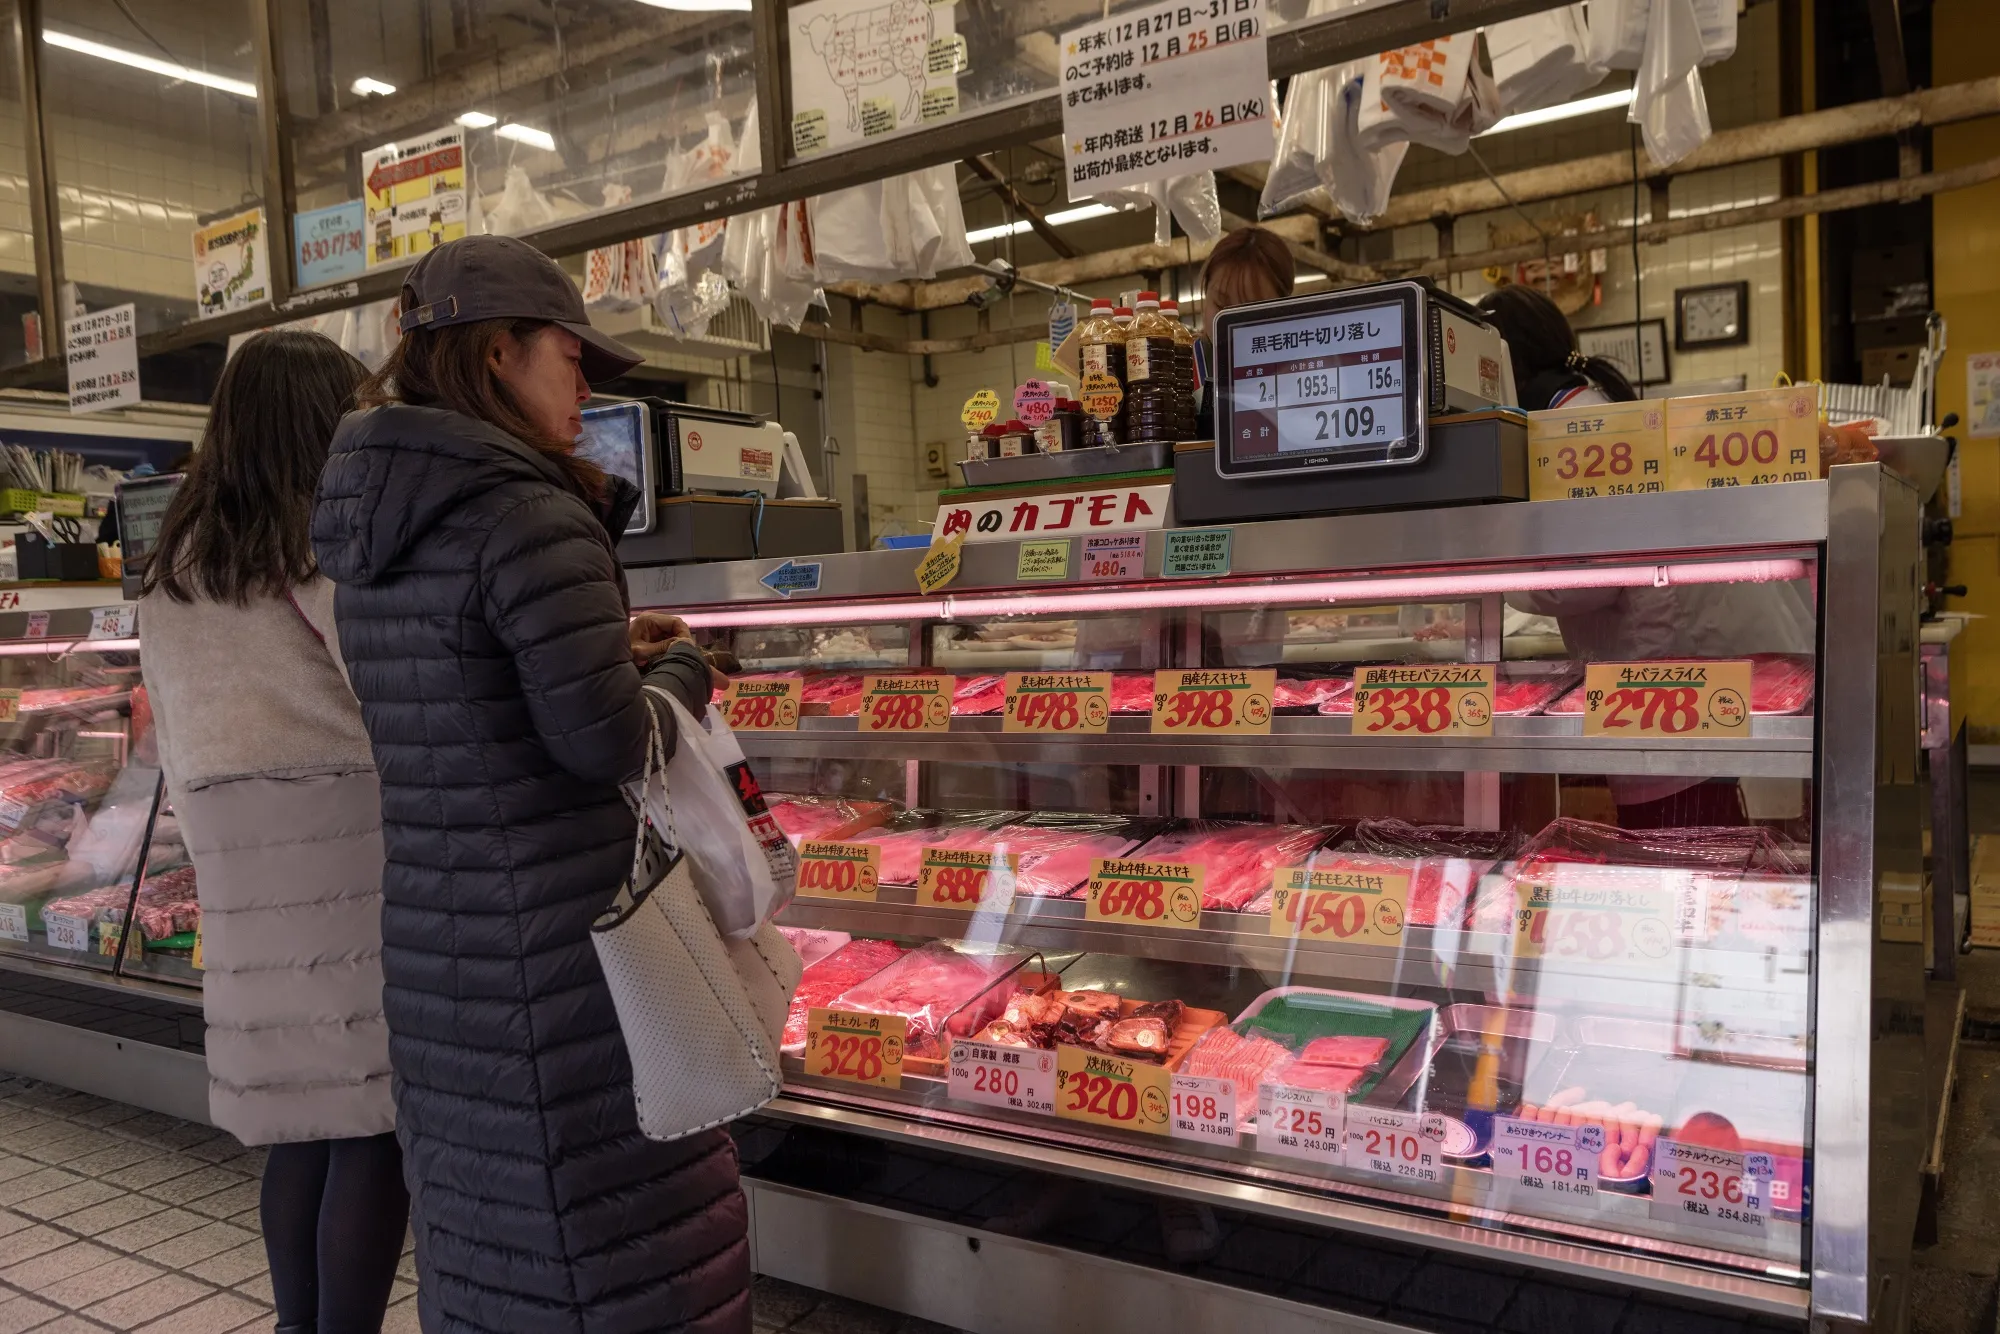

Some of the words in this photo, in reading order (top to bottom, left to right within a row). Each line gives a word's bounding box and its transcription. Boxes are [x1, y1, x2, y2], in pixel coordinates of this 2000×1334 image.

[1066, 52, 1134, 81] のご予約は
[1067, 74, 1152, 107] まで承ります。
[1085, 125, 1143, 153] 年内発送
[1073, 138, 1217, 182] 出荷が最終となります。
[1251, 322, 1381, 354] 黒毛和牛切り落し
[1705, 407, 1748, 422] 赤玉子
[1567, 419, 1605, 434] 白玉子
[1674, 446, 1687, 457] 1P
[1694, 430, 1779, 468] 400
[1536, 457, 1549, 467] 1P
[1556, 442, 1634, 479] 328
[1608, 482, 1665, 496] 3542円)
[1087, 537, 1140, 548] 冷凍コロッケあります
[1170, 534, 1226, 544] 肉の重なり合った部分が
[1174, 543, 1221, 553] 黒く変色する場合が
[1175, 563, 1216, 572] 問題ございません
[1019, 676, 1091, 688] 黒毛和牛スキヤキ
[1181, 672, 1247, 685] 国産牛スキヤキ
[1366, 668, 1482, 683] 国産牛モモバラスライス
[1620, 668, 1707, 682] 牛バラスライス
[874, 679, 939, 690] 黒毛和牛上スキヤキ
[803, 844, 868, 858] 黒毛和牛特選スキヤキ
[1100, 860, 1189, 878] 黒毛和牛特上スキヤキ
[1293, 871, 1383, 889] 国産牛モモスキヤキ
[1530, 887, 1650, 906] 黒毛和牛切り落とし
[828, 1013, 879, 1030] 特上カレー肉
[972, 1048, 997, 1061] 自家製
[1002, 1052, 1020, 1064] 焼豚
[952, 1067, 968, 1078] 100g
[1085, 1055, 1134, 1077] 焼豚バラ
[1275, 1091, 1312, 1103] ボンレスハム
[1369, 1116, 1403, 1127] バイエルン
[1349, 1132, 1363, 1140] 100g
[1506, 1125, 1571, 1140] あらびきウインナー
[1498, 1147, 1512, 1155] 100g
[1669, 1147, 1742, 1166] カクテルウインナー
[1398, 1165, 1437, 1181] 226.8円)
[1659, 1168, 1676, 1178] 100g
[1552, 1180, 1594, 1196] 181.4円)
